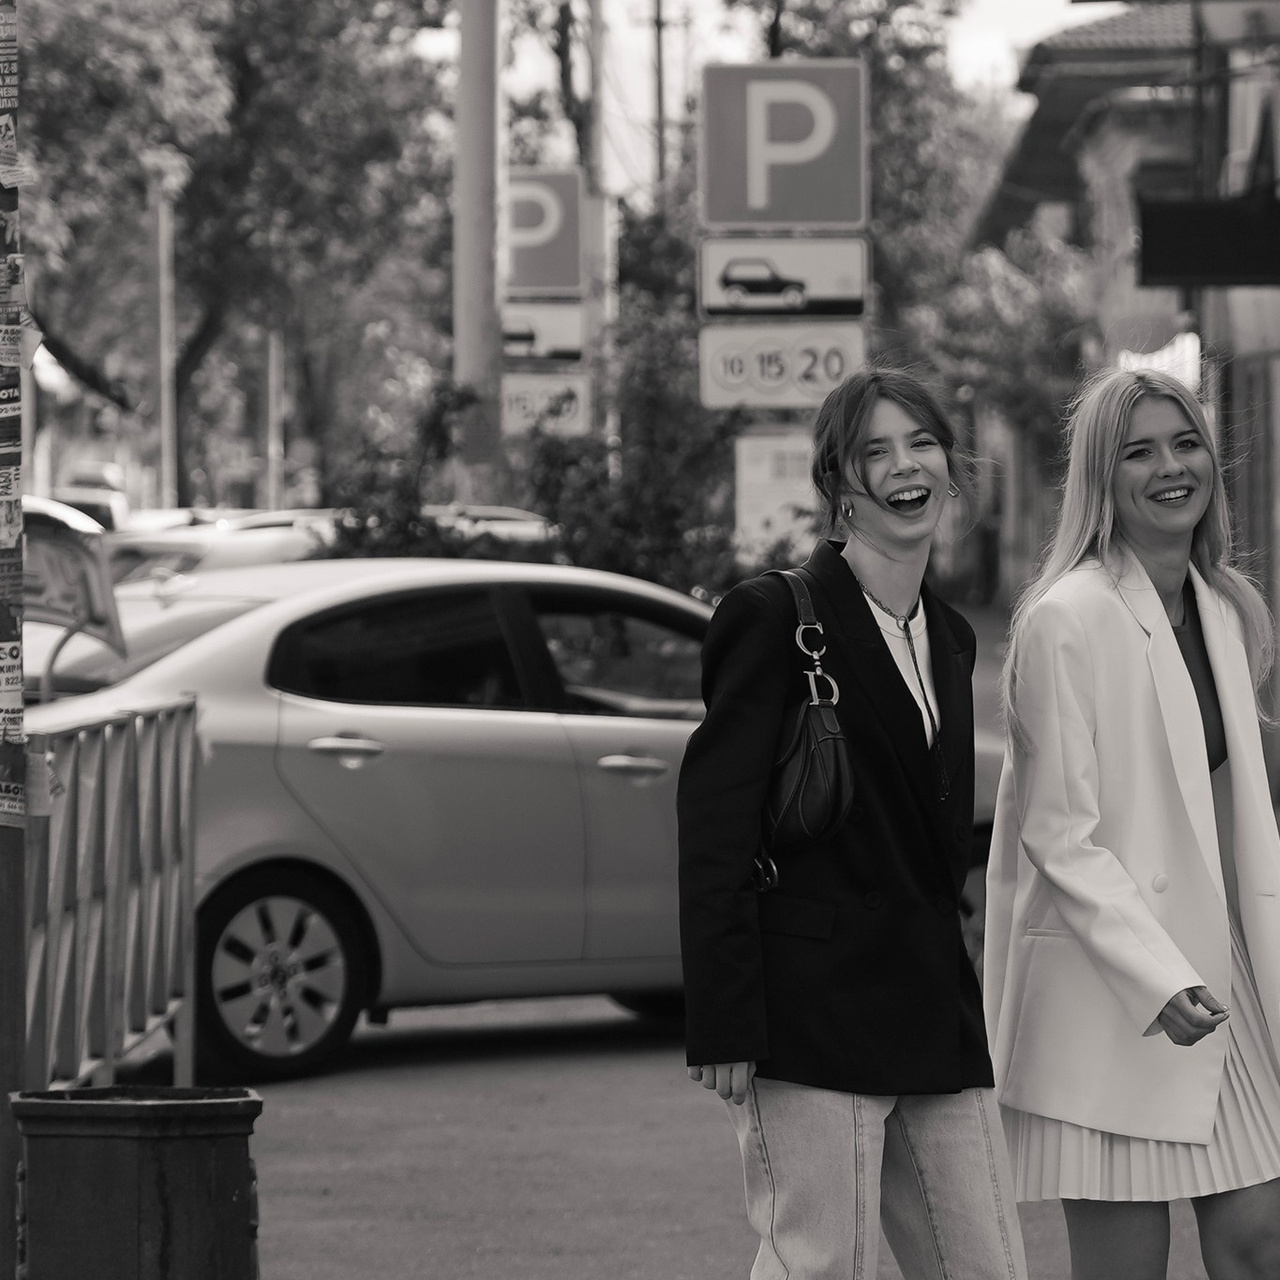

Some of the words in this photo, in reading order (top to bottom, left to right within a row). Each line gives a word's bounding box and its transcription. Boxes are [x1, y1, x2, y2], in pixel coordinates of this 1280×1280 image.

[746, 79, 837, 209] P
[757, 350, 785, 379] 15
[798, 347, 845, 383] 20
